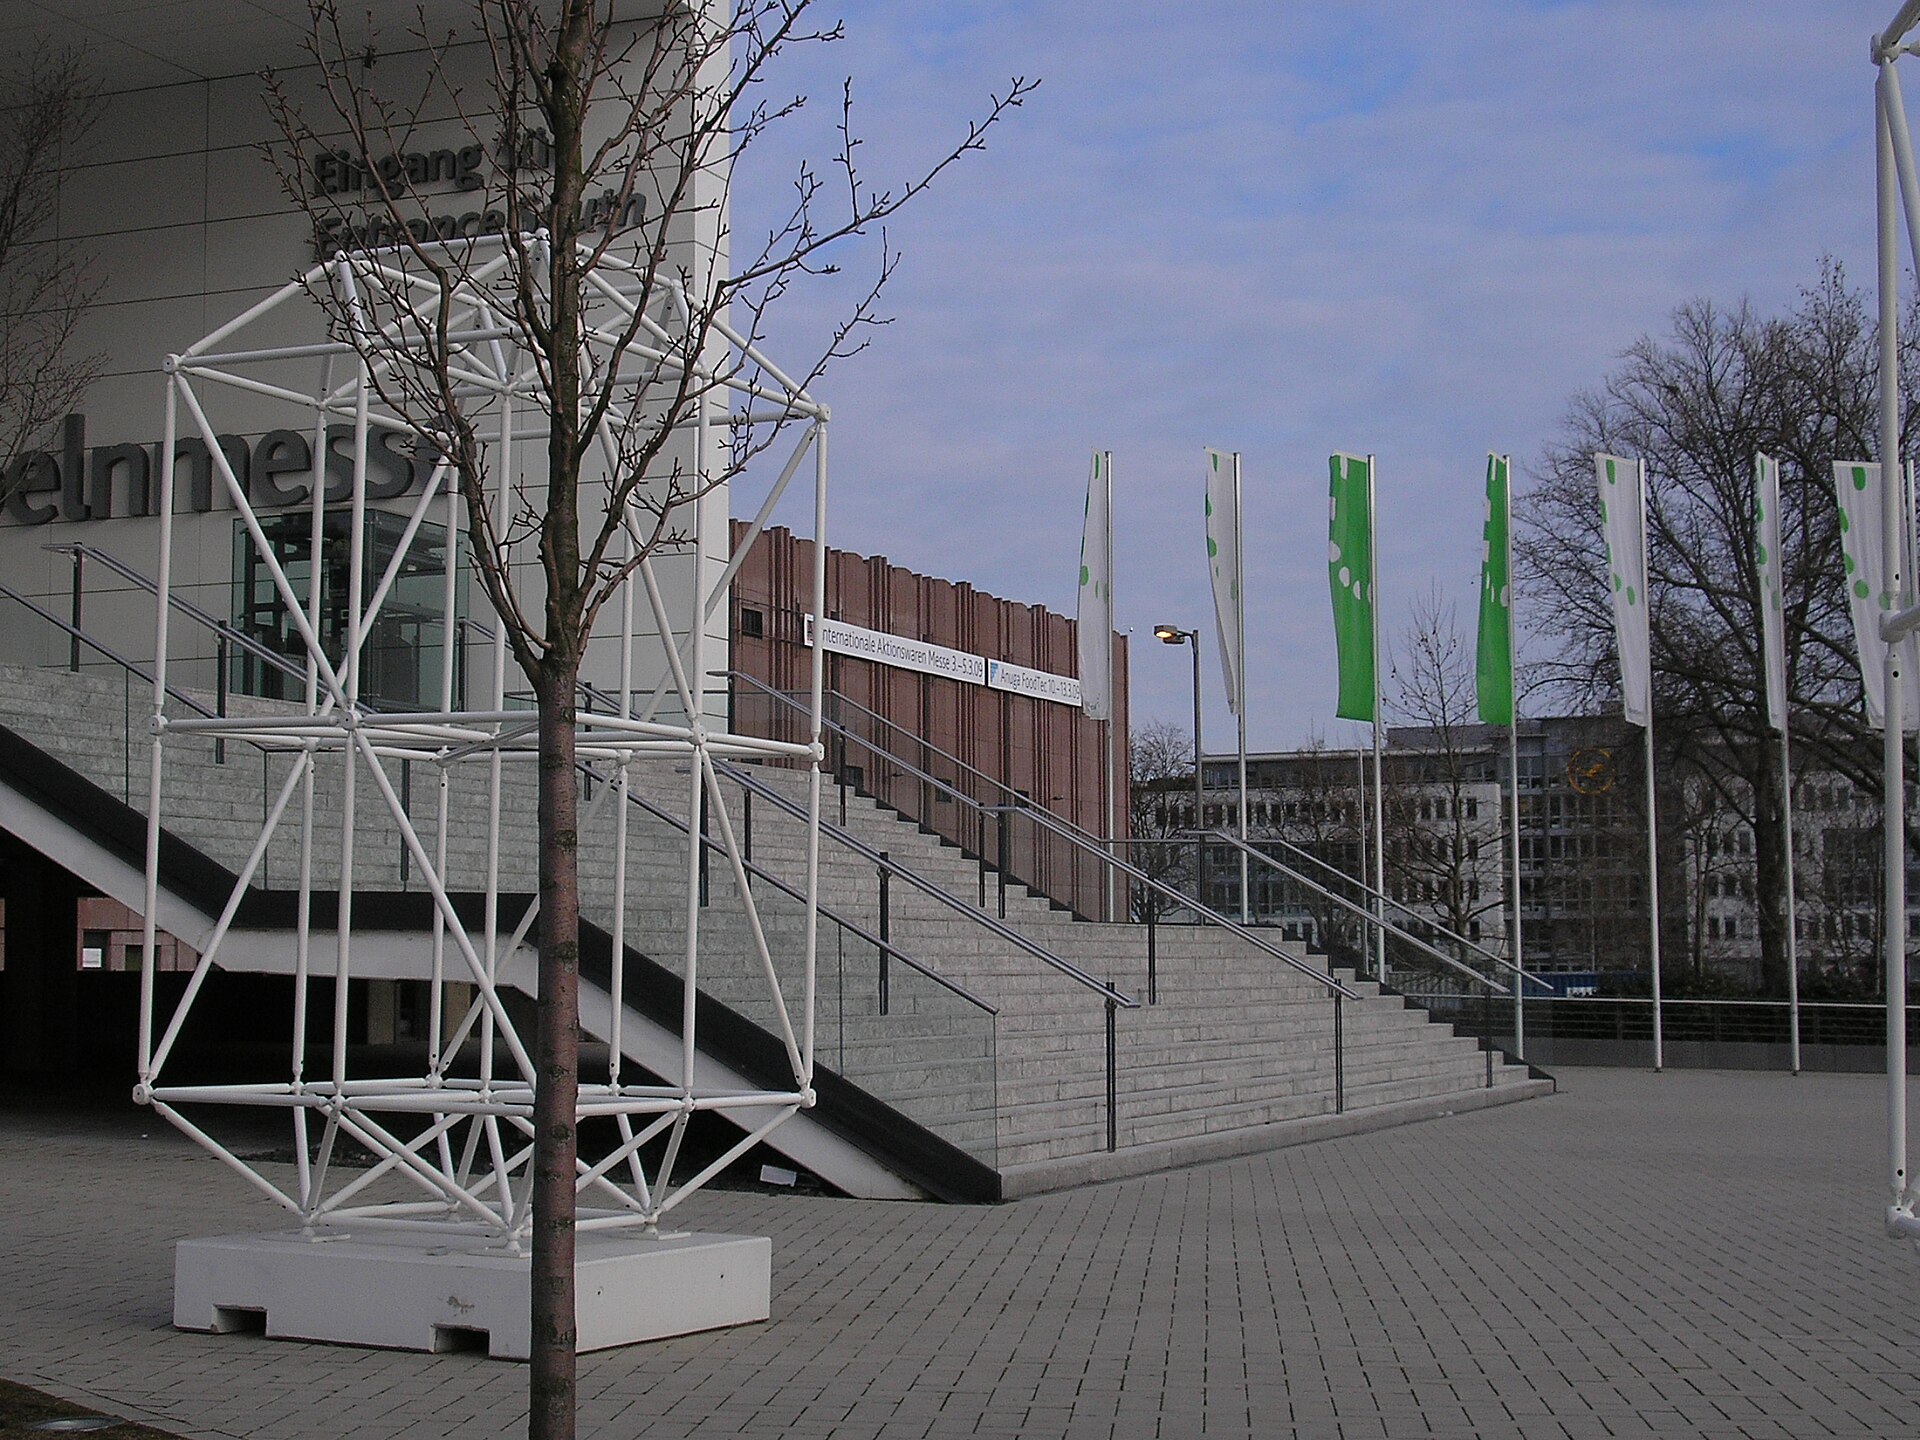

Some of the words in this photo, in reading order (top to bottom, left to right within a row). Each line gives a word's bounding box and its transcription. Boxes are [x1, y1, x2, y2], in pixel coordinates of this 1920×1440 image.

[315, 144, 483, 199] Eingang
[821, 626, 876, 653] nternationale
[876, 636, 927, 664] Aktionswaren
[928, 649, 950, 670] Messe
[1000, 668, 1021, 690] Anuga
